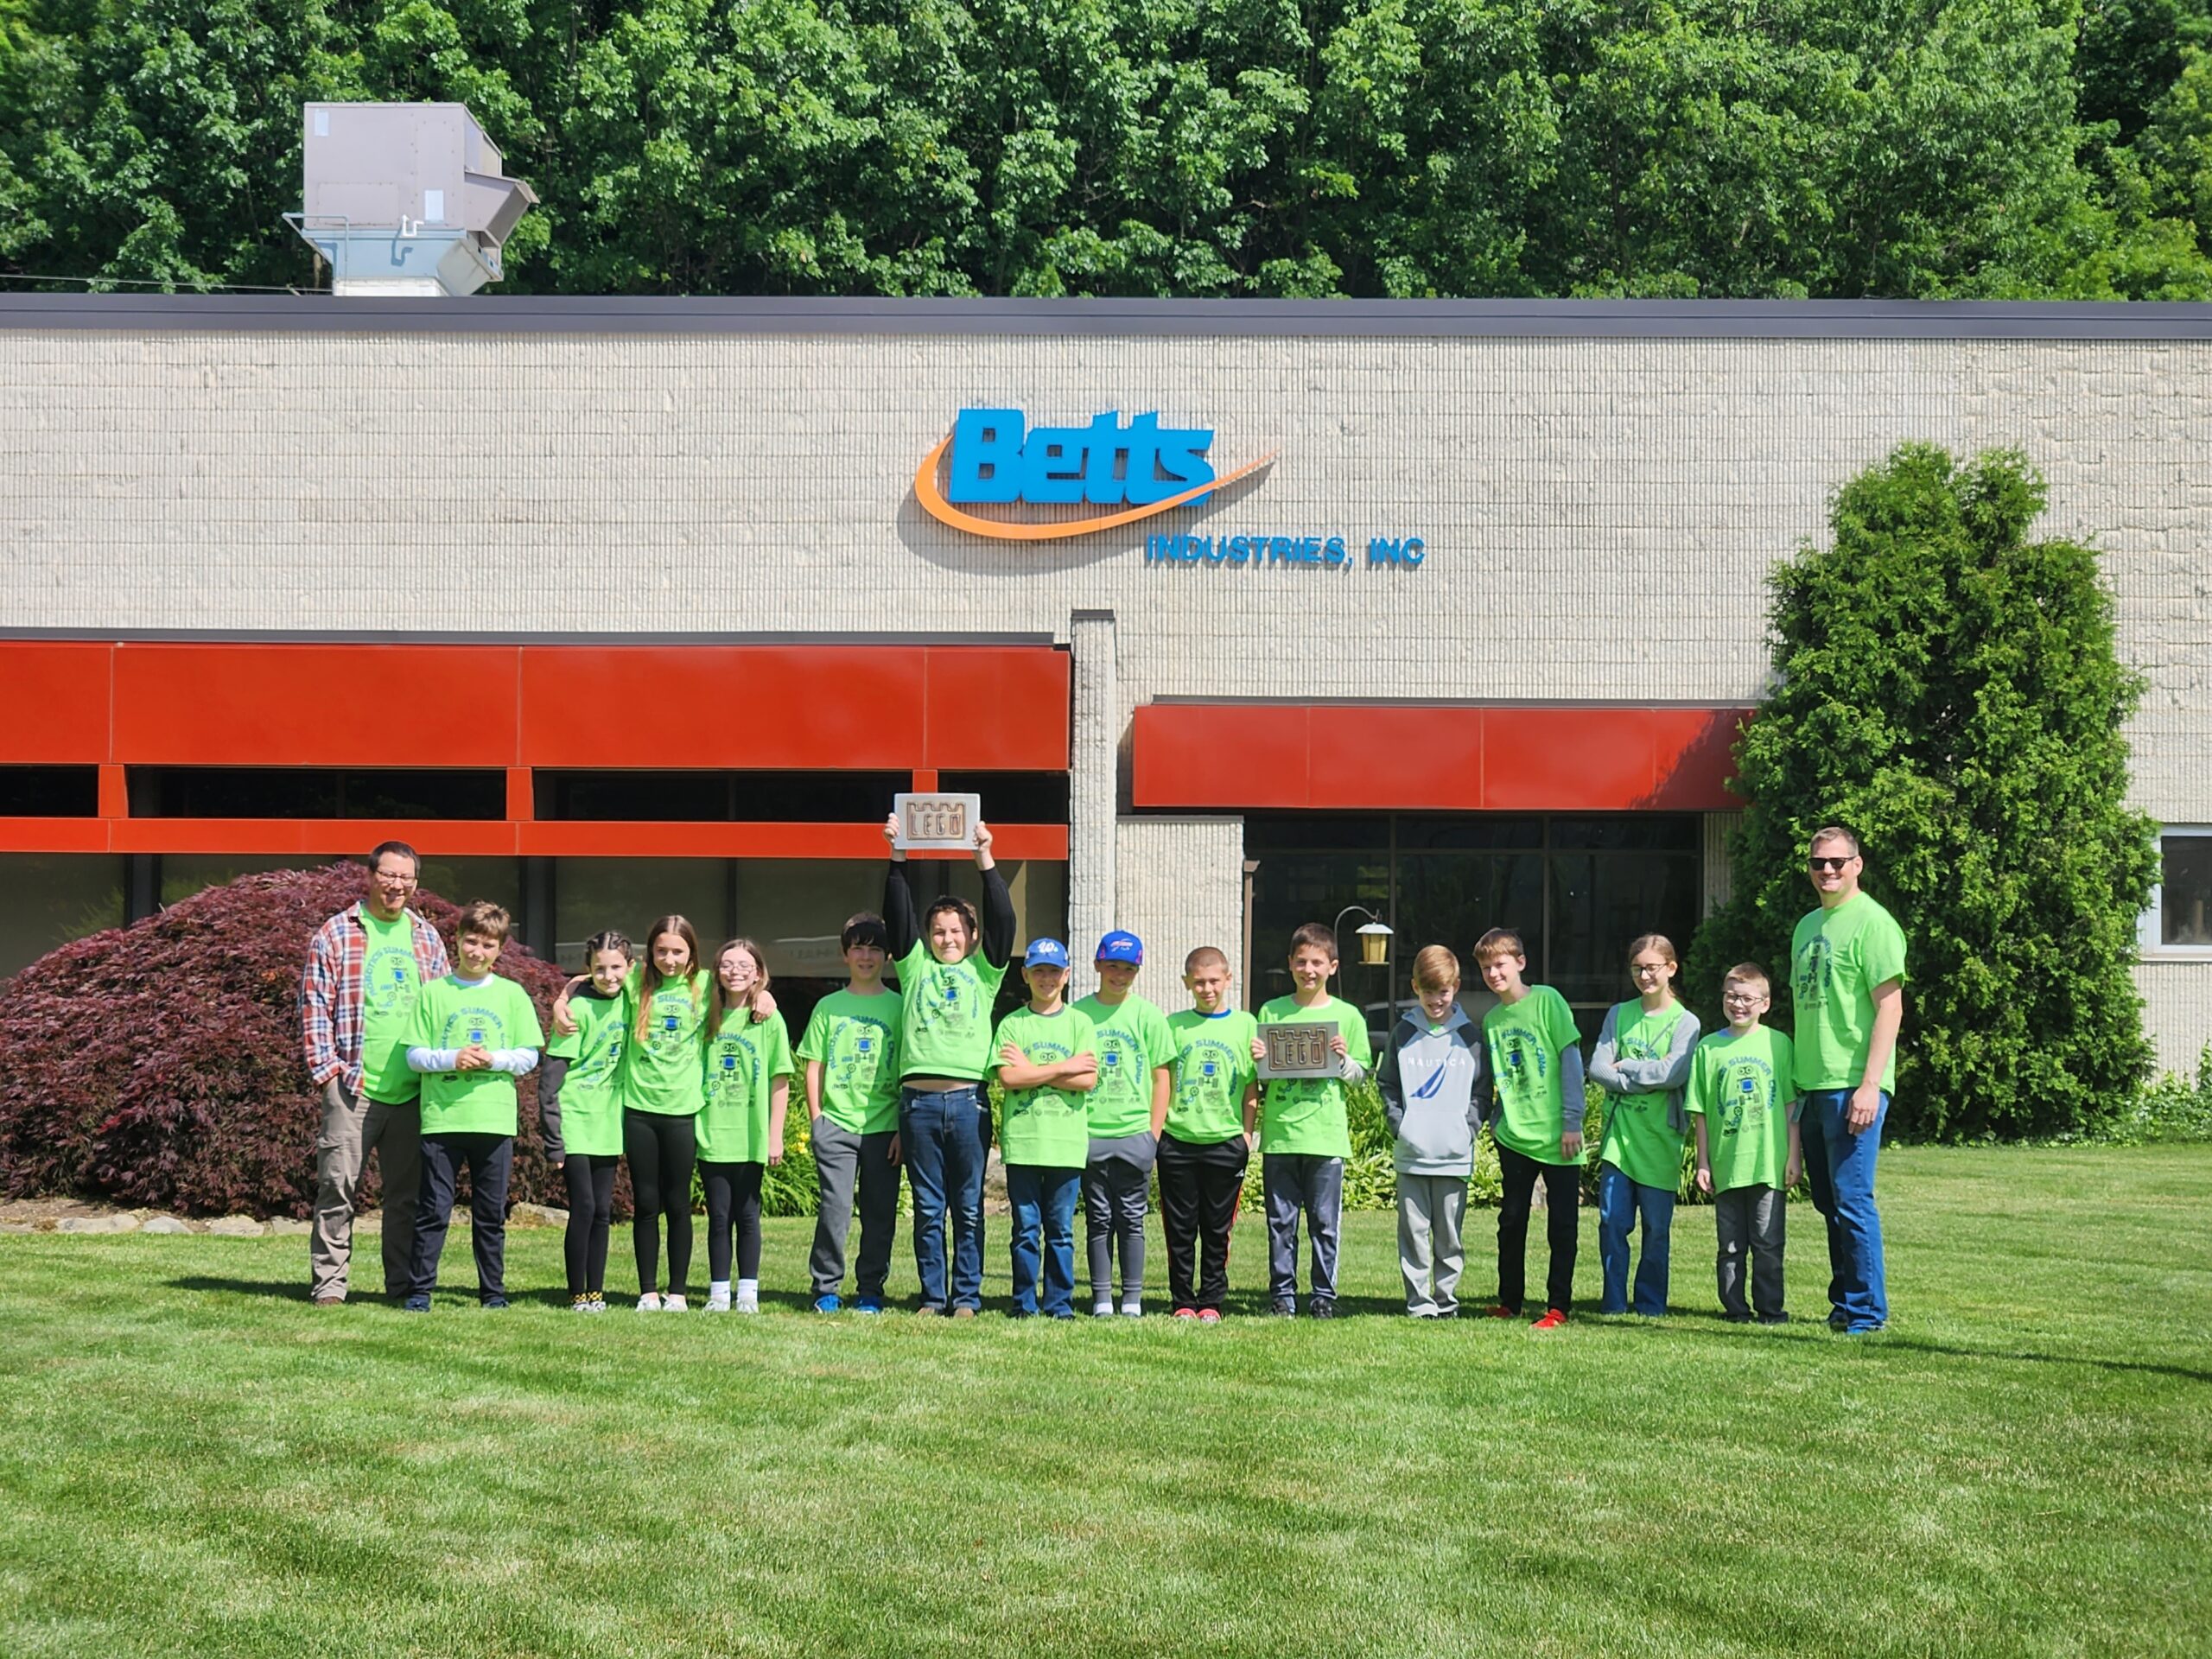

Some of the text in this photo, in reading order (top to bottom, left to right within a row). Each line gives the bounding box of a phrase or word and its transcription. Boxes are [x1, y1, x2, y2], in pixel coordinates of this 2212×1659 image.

[951, 409, 1214, 506] Betts
[1147, 534, 1426, 567] INDUSTRIES, INC
[912, 813, 961, 836] LEGO
[461, 1007, 504, 1029] SUMMER
[1032, 1041, 1071, 1059] SUMME
[1096, 1028, 1140, 1052] SUMMER
[1196, 1039, 1235, 1063] SUMMER
[1273, 1041, 1322, 1065] LEGO
[1408, 1057, 1466, 1069] NAUTICA
[1728, 1057, 1771, 1076] SUMMER
